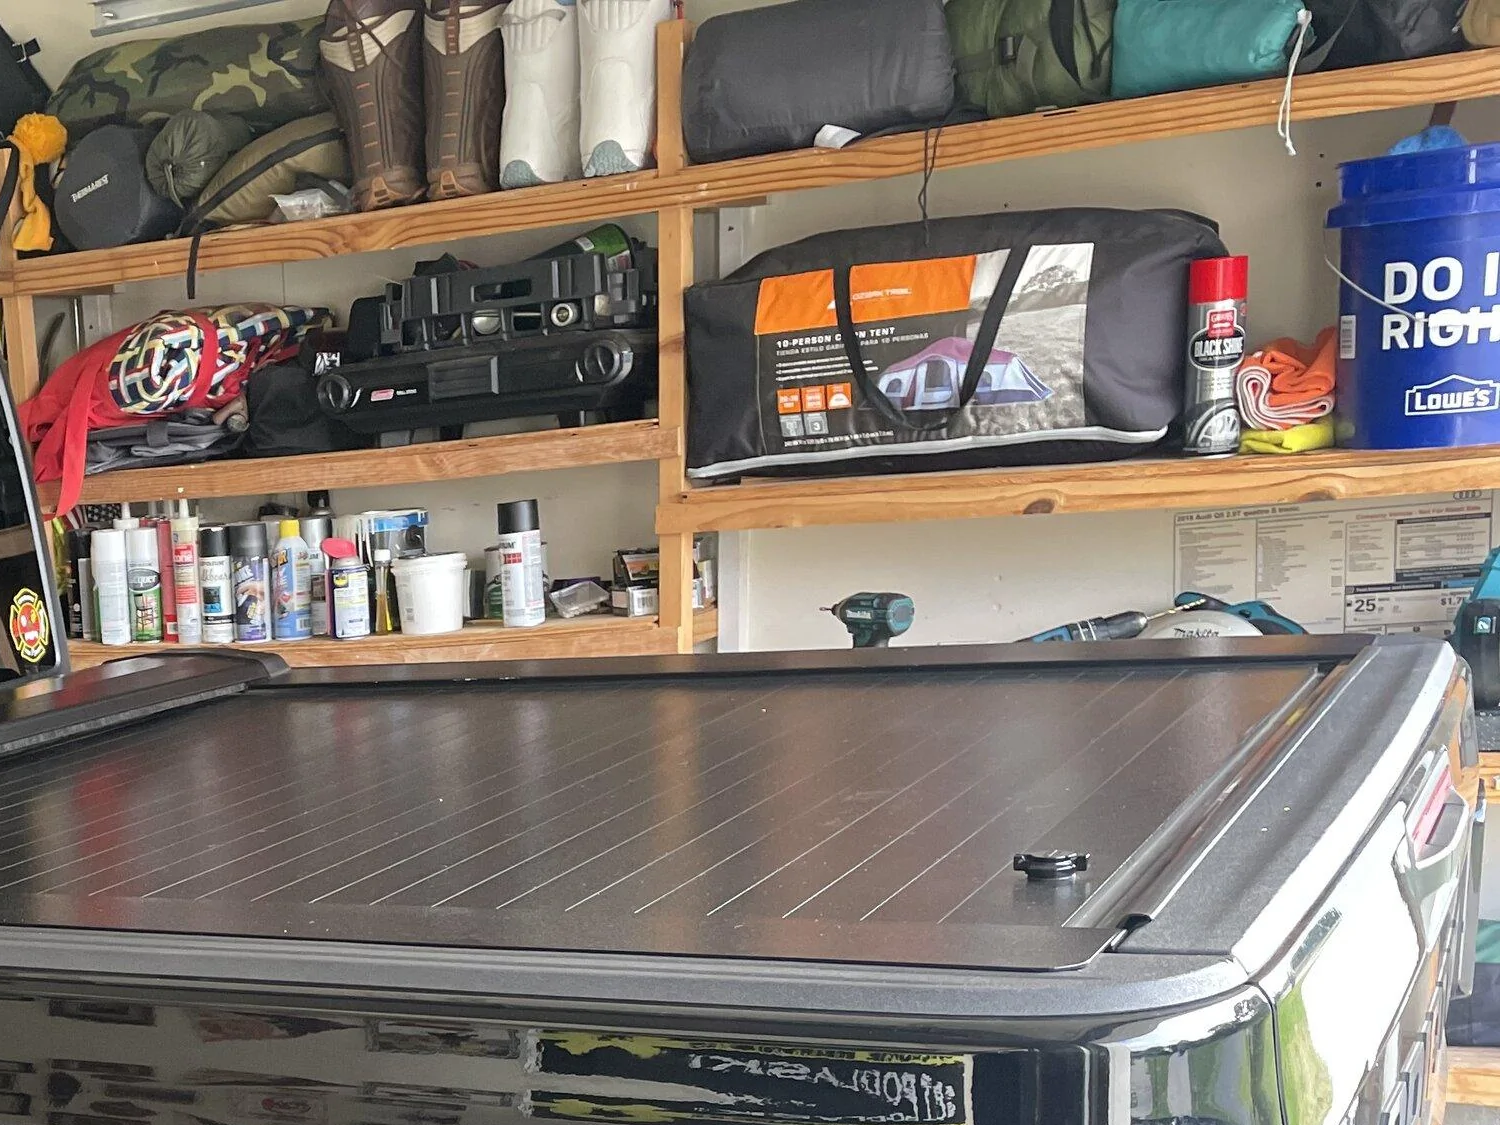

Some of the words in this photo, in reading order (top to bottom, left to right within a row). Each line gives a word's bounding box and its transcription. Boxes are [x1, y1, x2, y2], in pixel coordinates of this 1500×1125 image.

[1384, 256, 1464, 305] DO
[1482, 251, 1500, 298] I
[852, 289, 883, 301] OZARK
[884, 287, 912, 297] TRAIL
[776, 335, 831, 348] 10-PERSON
[869, 327, 896, 337] TENT
[1382, 304, 1500, 351] RIGH
[1194, 338, 1222, 358] BLACK
[1222, 336, 1244, 354] SHINE
[1414, 387, 1491, 411] LOWE'S
[1195, 512, 1212, 521] Audi
[1354, 598, 1377, 613] 25
